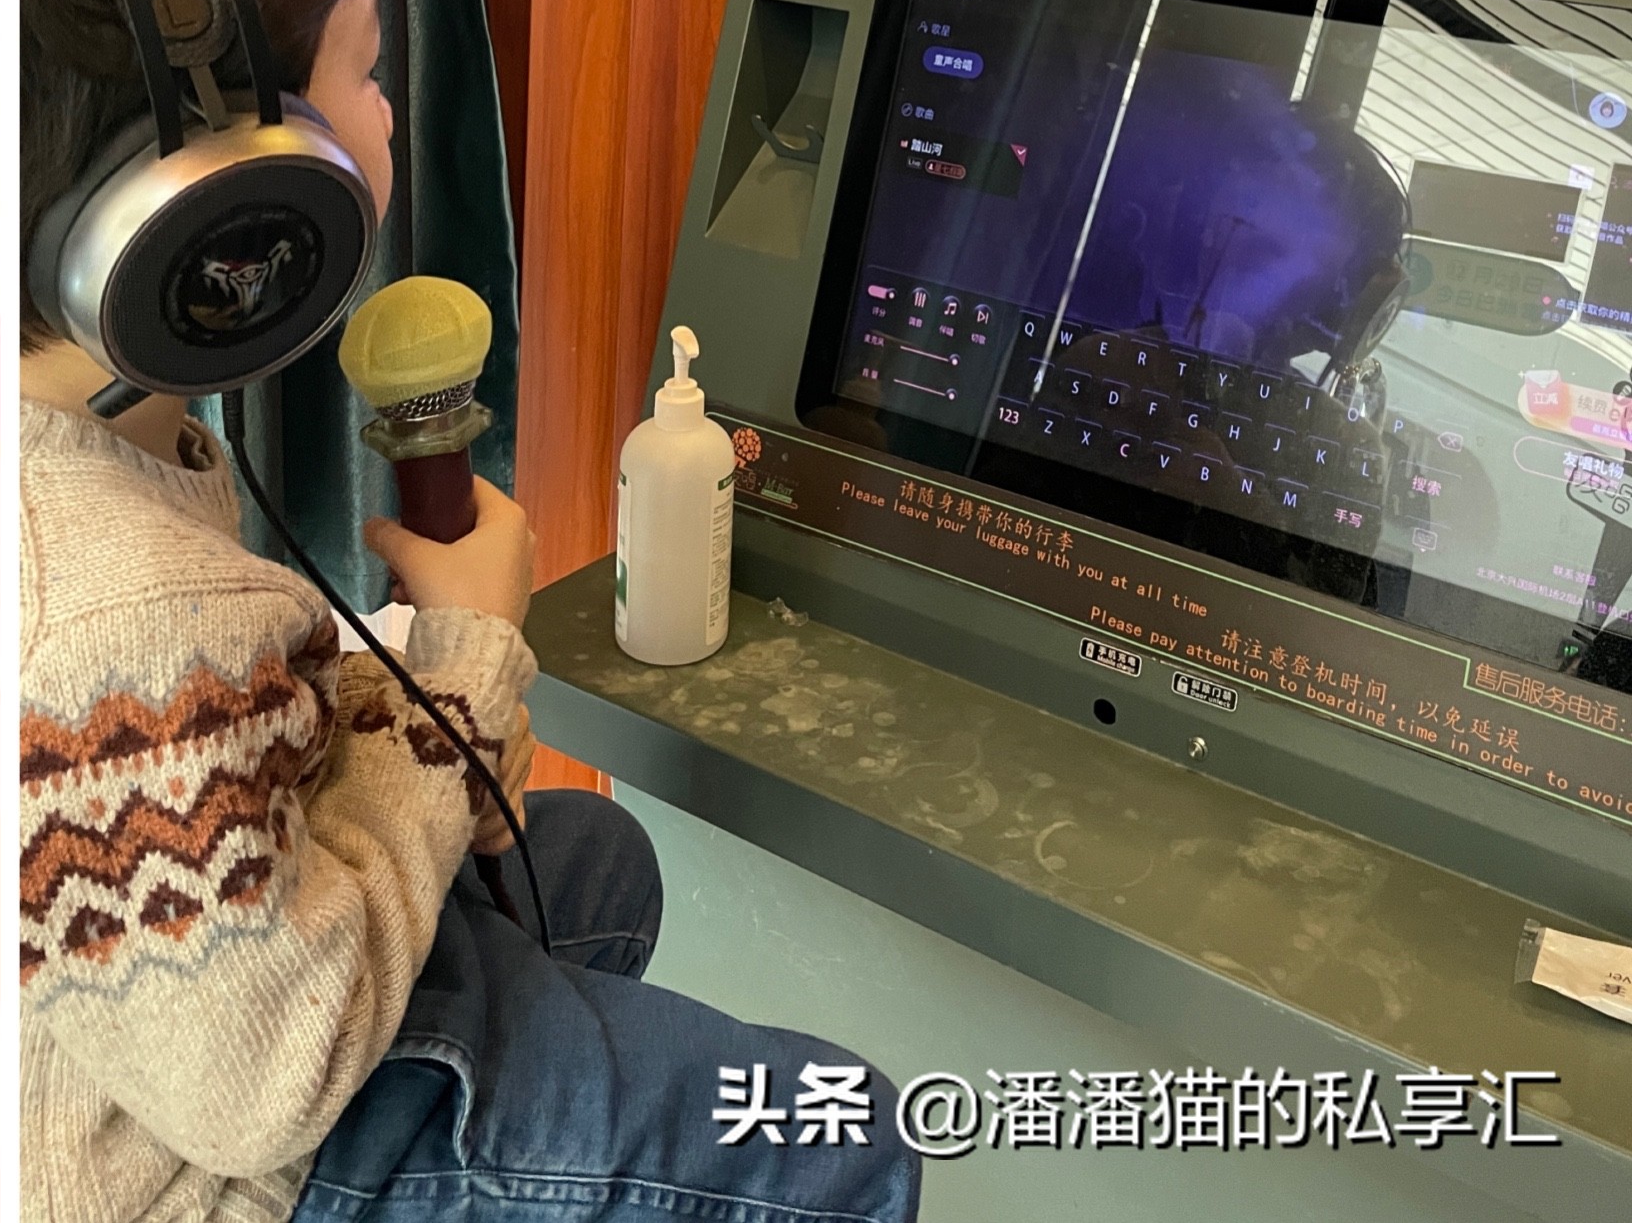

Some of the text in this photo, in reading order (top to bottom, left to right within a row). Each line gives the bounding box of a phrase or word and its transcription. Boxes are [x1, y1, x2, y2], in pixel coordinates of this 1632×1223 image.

[933, 54, 973, 72] 童声合唱
[911, 138, 943, 157] 踏山河
[1024, 322, 1035, 338] Q
[1060, 330, 1073, 345] W
[1099, 342, 1108, 356] E
[1137, 351, 1147, 366] R
[1178, 362, 1187, 376] T
[1218, 372, 1228, 387] Y
[1259, 384, 1270, 399] U
[1347, 407, 1359, 422] O
[1394, 419, 1404, 434] P
[1071, 380, 1080, 395] S
[1108, 390, 1119, 405] D
[1149, 402, 1157, 416] F
[1188, 413, 1198, 428] G
[1229, 424, 1240, 440] H
[1272, 437, 1281, 452] J
[1316, 449, 1326, 465] K
[1362, 461, 1369, 477] L
[998, 407, 1297, 508] 123 Z X C V B N M
[1563, 451, 1625, 480] 友唱礼物
[1412, 475, 1442, 497] 搜索
[900, 480, 1074, 553] 请随身携带你的行李
[1334, 508, 1363, 528] 手写
[841, 481, 1207, 617] Please leave your luggage with you at all time
[1098, 645, 1137, 667] 手机充电
[1091, 606, 1142, 637] Please
[1150, 631, 1177, 651] pay
[1186, 644, 1269, 682] attention
[1279, 675, 1298, 692] to
[1307, 684, 1385, 727] boarding
[1396, 715, 1438, 743] time
[1450, 735, 1469, 755] in
[1480, 750, 1533, 776] order
[1546, 770, 1568, 789] to
[1190, 679, 1232, 702] 解除门禁
[1190, 689, 1231, 709] Door unlock
